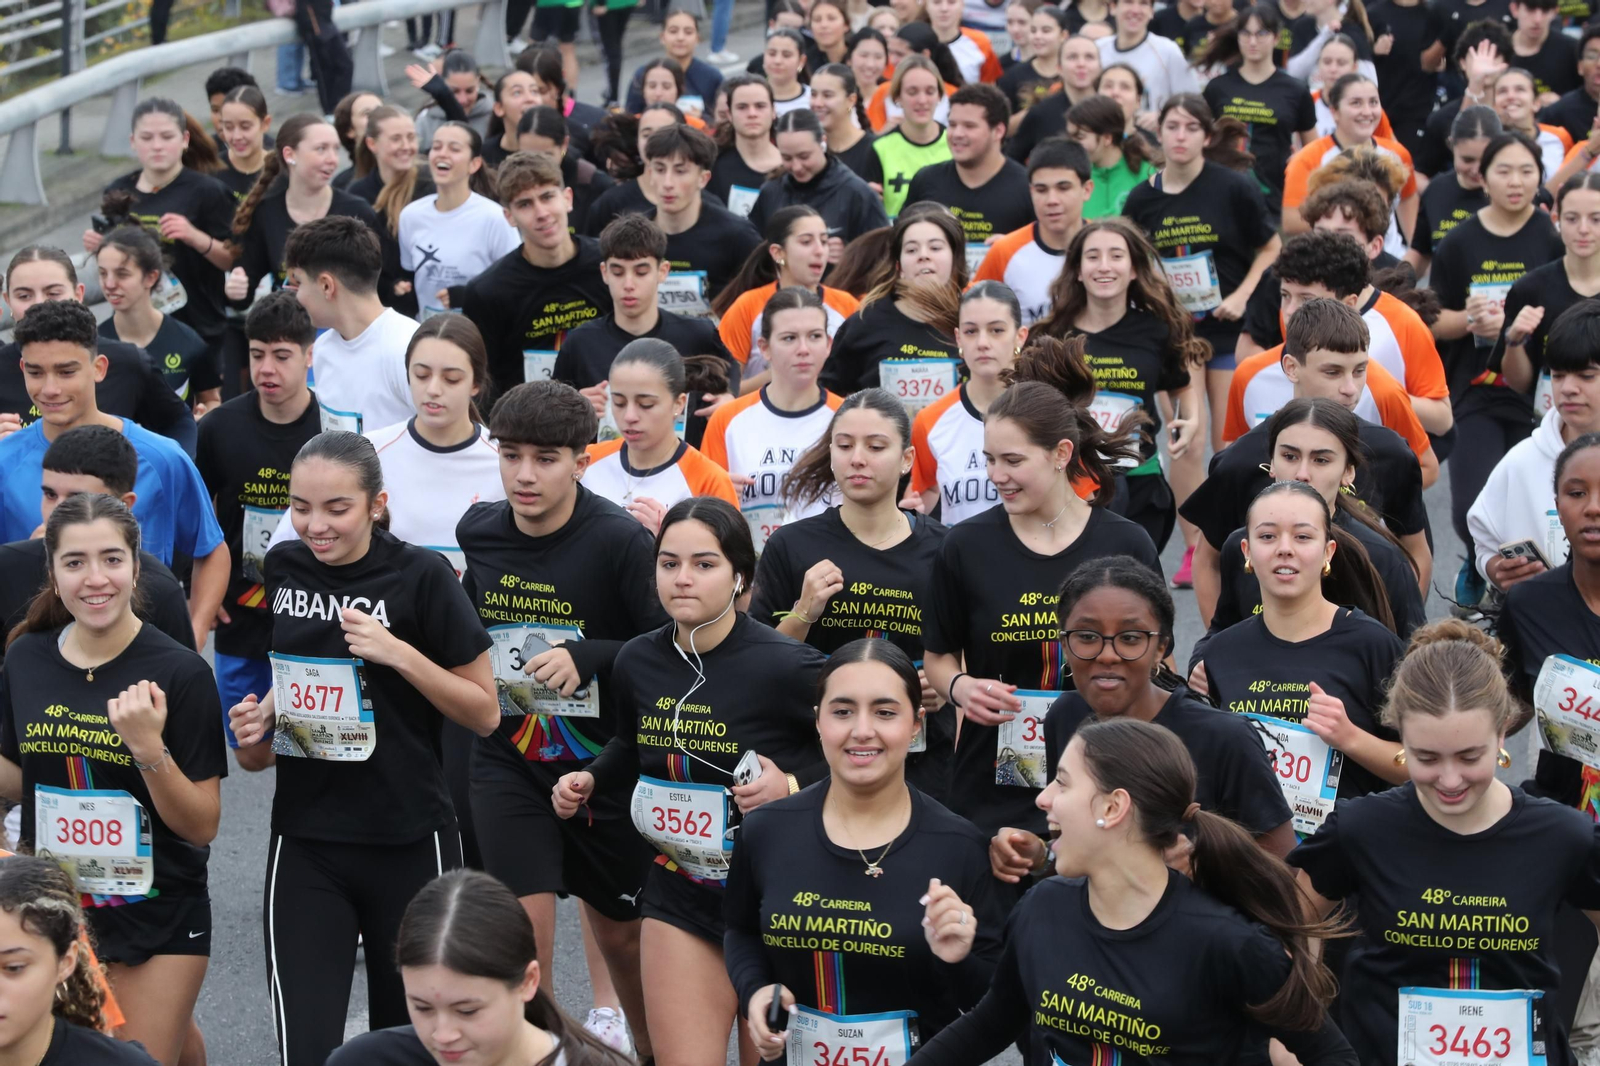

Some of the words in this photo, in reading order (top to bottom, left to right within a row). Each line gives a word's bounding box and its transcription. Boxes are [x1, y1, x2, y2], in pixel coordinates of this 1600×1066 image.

[532, 317, 553, 330] SAN
[554, 307, 597, 324] MARTIÑO
[918, 349, 948, 358] CARREIRA
[1092, 357, 1124, 365] CARREIRA
[897, 379, 944, 397] 3376
[1109, 381, 1145, 390] OURENSE
[244, 482, 267, 494] SAN
[520, 580, 555, 594] CARREIRA
[873, 587, 913, 600] CARREIRA
[484, 591, 509, 607] SAN
[512, 595, 572, 615] MARTIÑO
[832, 601, 860, 614] SAN
[479, 607, 523, 623] CONCELLO
[525, 614, 538, 624] DE
[1002, 613, 1030, 627] SAN
[821, 617, 871, 629] CONCELLO
[874, 620, 887, 630] DE
[890, 621, 921, 636] OUREN
[991, 630, 1046, 642] CONCELLO
[305, 668, 320, 677] SAGA
[1272, 684, 1310, 692] CARREIRA
[290, 682, 343, 712] 3677
[1229, 700, 1256, 713] SAN
[1260, 698, 1310, 713] MARTIÑ
[69, 711, 108, 725] CARREIRA
[641, 715, 661, 731] SAN
[664, 718, 726, 737] MARTIÑO
[26, 723, 53, 737] SAN
[56, 724, 122, 747] MARTIÑO
[637, 733, 671, 748] CONCELLO
[673, 737, 686, 749] DE
[689, 739, 738, 753] OURENSE
[20, 741, 68, 754] CONCELLO
[82, 746, 131, 767] OURENSE
[669, 792, 692, 803] ESTELA
[79, 802, 95, 811] INES
[1295, 803, 1323, 817] XLVIII
[651, 806, 712, 838] 3562
[56, 817, 122, 846] 3808
[820, 899, 871, 911] CARREIRA
[1452, 896, 1507, 907] CARREIRA
[770, 913, 801, 931] SAN
[806, 916, 892, 938] MARTIÑO
[1397, 910, 1434, 929] SAN
[1440, 914, 1529, 933] MARTIÑO
[763, 933, 819, 949] CONCELLO
[822, 938, 840, 950] DE
[843, 940, 905, 958] OURENSE
[1384, 930, 1453, 949] CONCELLO
[1457, 937, 1475, 949] DE
[1479, 938, 1539, 950] OURENSE
[1094, 986, 1141, 1010] CARREIRA
[1408, 1000, 1422, 1010] SUB
[1424, 1001, 1433, 1011] 18
[1040, 990, 1074, 1015] SAN
[1077, 1001, 1161, 1040] MARTIÑO
[1459, 1005, 1484, 1016] IRENE
[797, 1015, 809, 1026] SUB
[811, 1019, 818, 1028] 18
[838, 1028, 863, 1038] SUZAN
[1035, 1011, 1090, 1036] ONCELLO
[1093, 1028, 1110, 1043] DE
[1114, 1034, 1171, 1056] OURENSE
[1429, 1024, 1511, 1058] 3463
[814, 1041, 889, 1066] 3454
